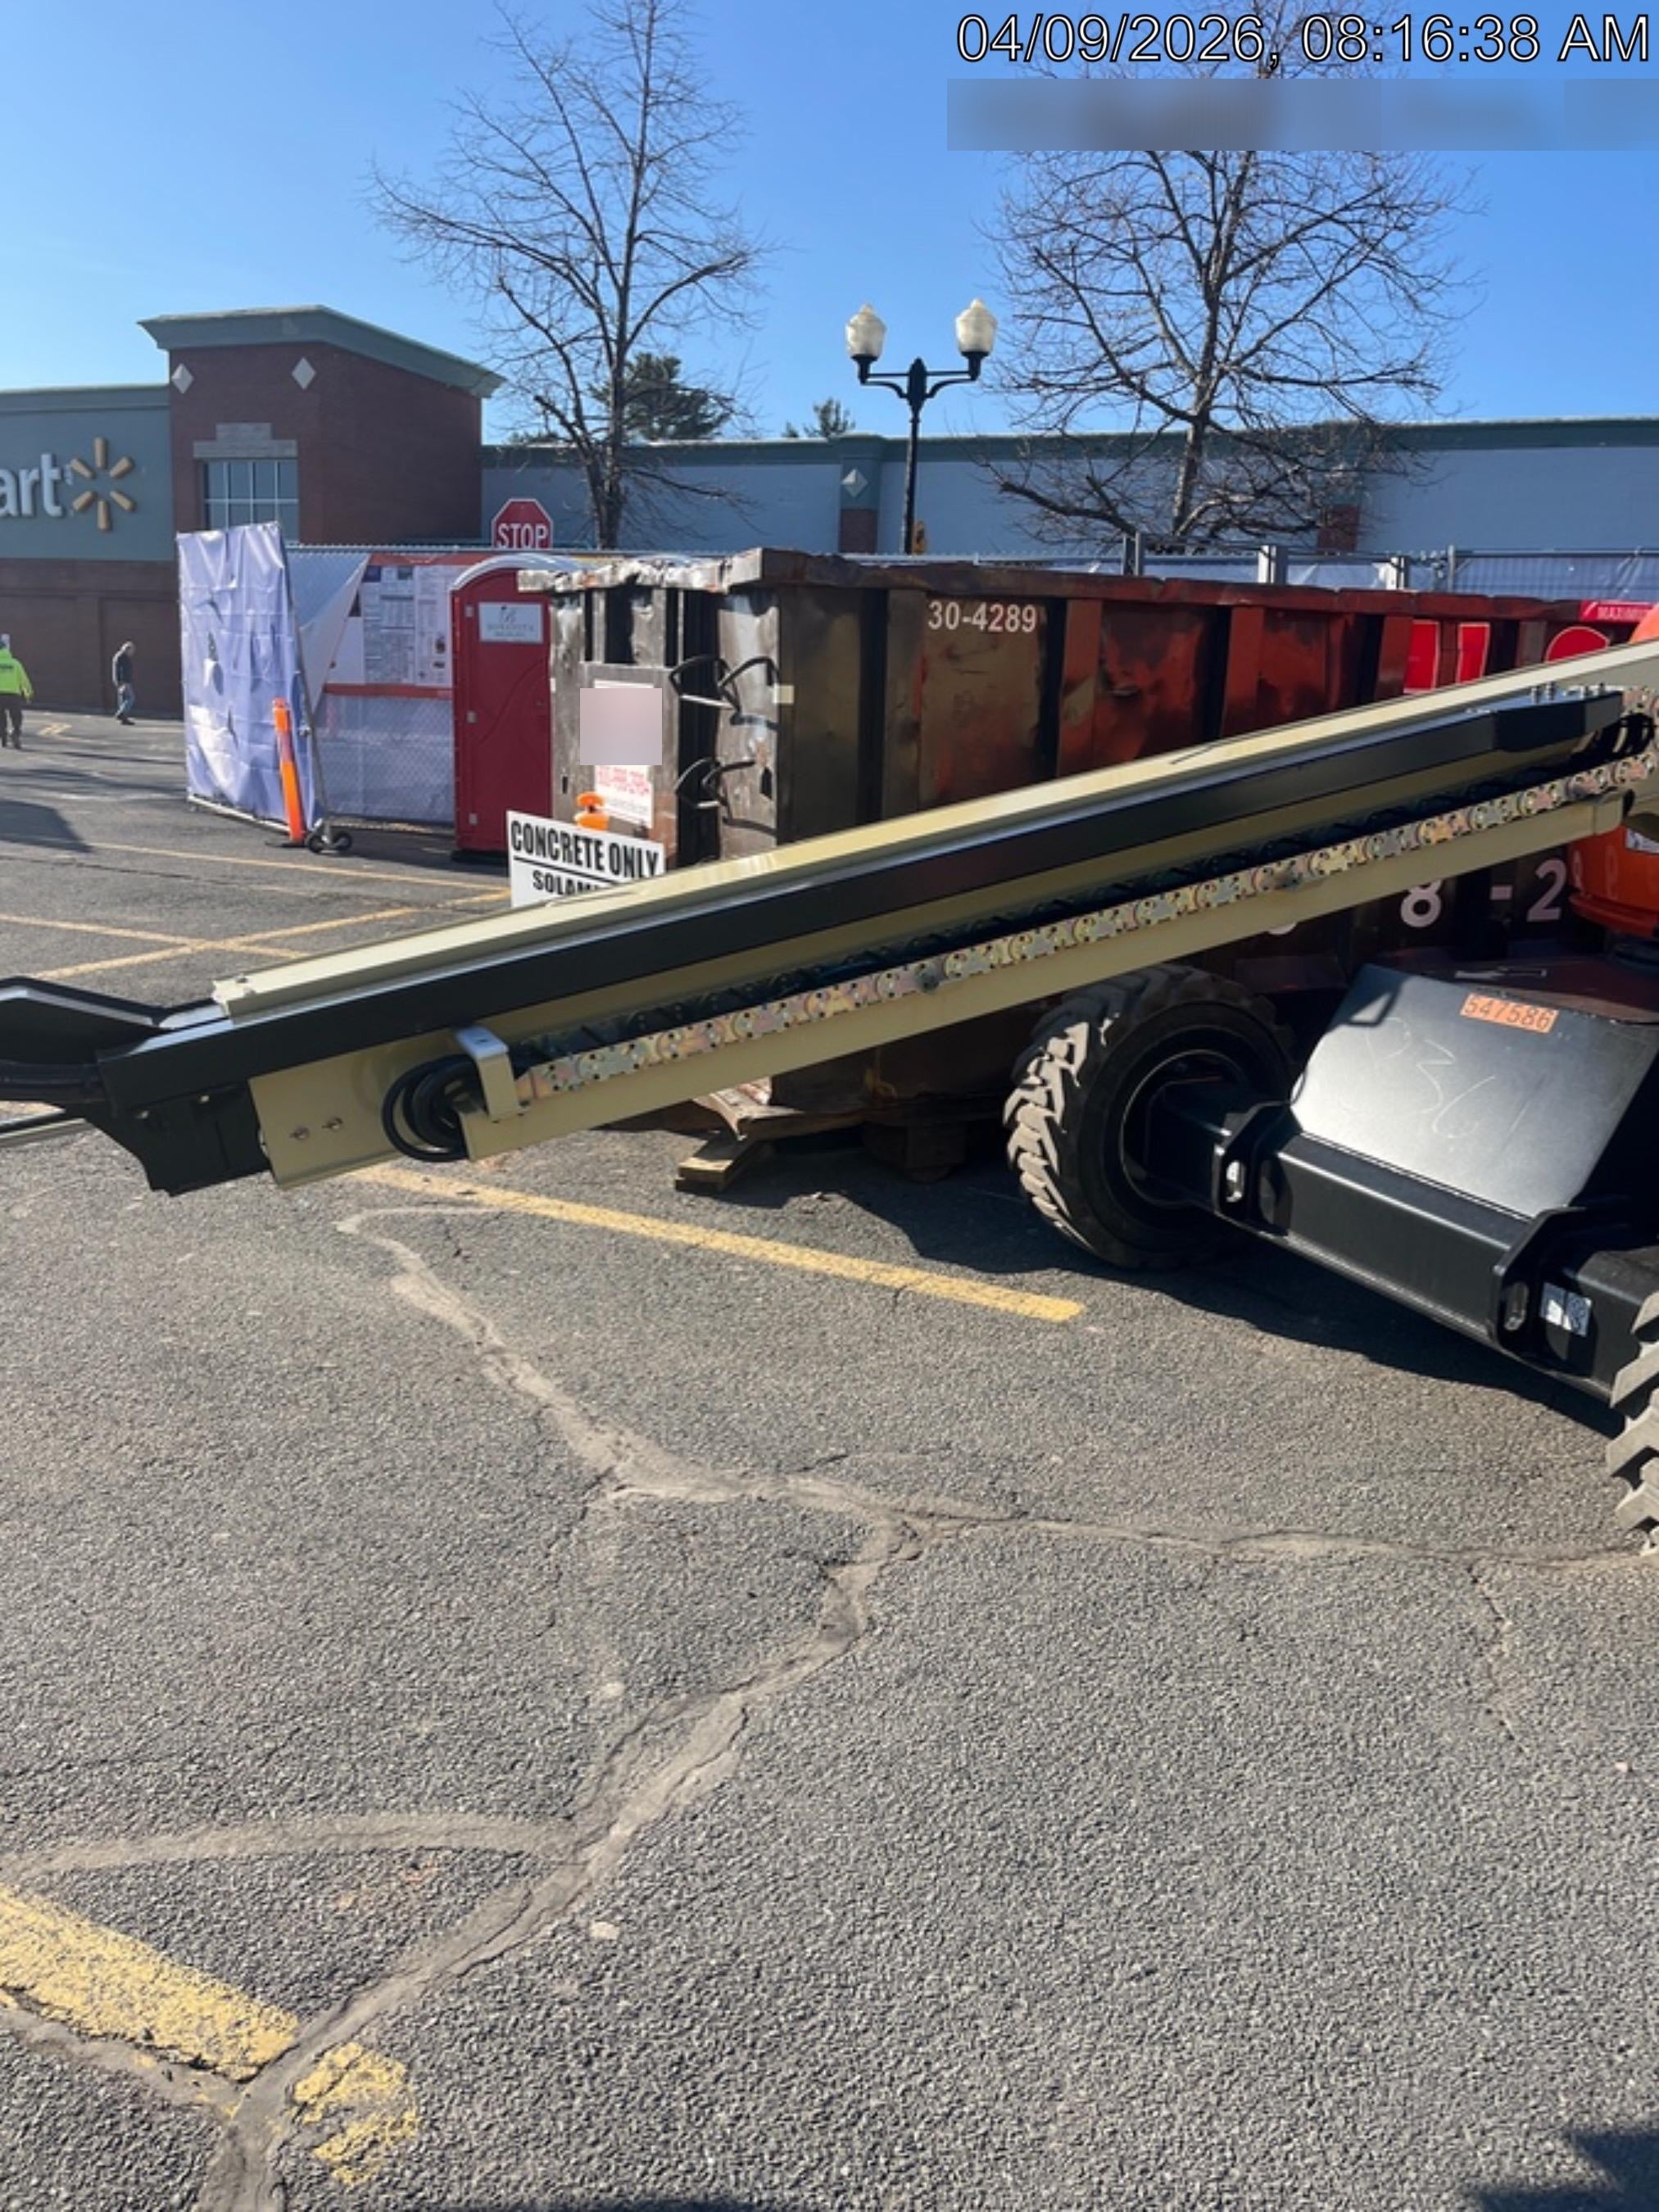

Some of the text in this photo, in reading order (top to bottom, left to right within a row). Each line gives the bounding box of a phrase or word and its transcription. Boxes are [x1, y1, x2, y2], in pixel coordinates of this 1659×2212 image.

[496, 523, 549, 549] STOP
[927, 600, 1037, 633] 30-4289
[510, 820, 659, 878] CONCRETE ONLY
[1464, 999, 1555, 1031] 547586
